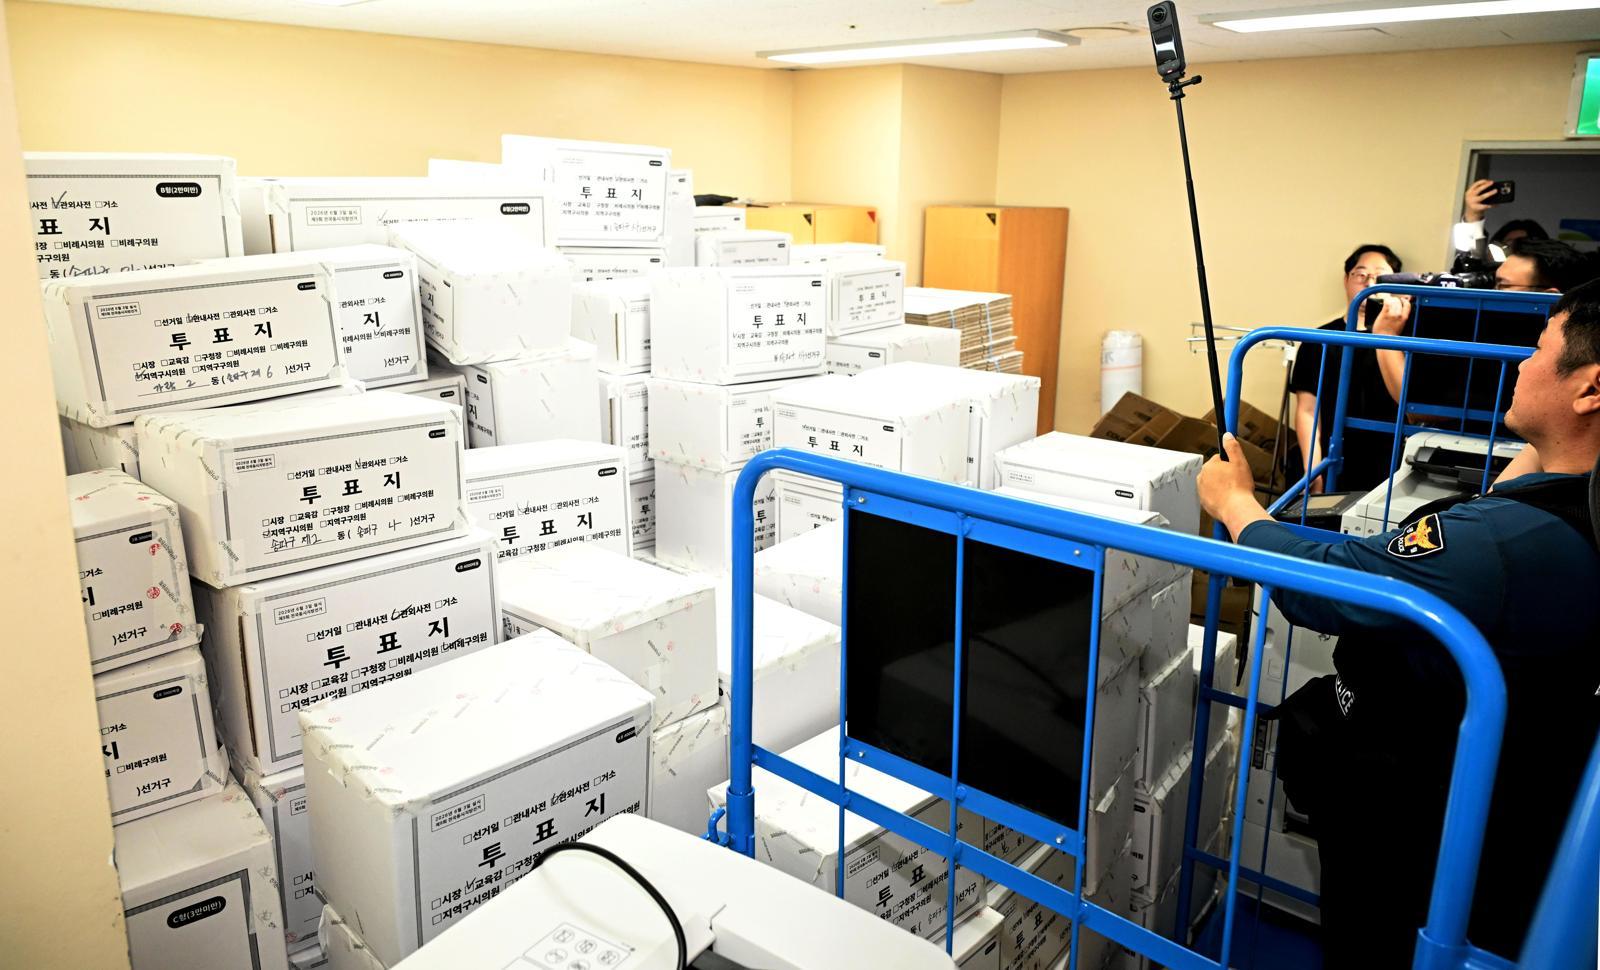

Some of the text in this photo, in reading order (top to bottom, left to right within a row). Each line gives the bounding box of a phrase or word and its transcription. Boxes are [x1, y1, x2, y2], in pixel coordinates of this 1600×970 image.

[30, 201, 48, 209] 사전
[103, 201, 119, 209] 거소
[62, 238, 159, 250] 비례시의원 비례구의원
[162, 316, 183, 327] 선거일
[230, 308, 256, 318] 관외사전
[265, 306, 278, 314] 거소
[380, 327, 411, 338] 비례구의원
[141, 339, 308, 370] 시장 교육감 구청장 비례시의원 비례구의원
[143, 360, 240, 381] 지역구시의원 지역구구의원
[294, 455, 409, 480] 선거일 관내사전 관외사전 거소
[270, 489, 434, 526] 시장 교육감 구청장 비례시의원 비례구의원
[496, 496, 600, 520] 선거일 관내사전 관외사전 거소
[270, 513, 367, 537] 지역구시의원 지역구구의원
[498, 548, 519, 559] 교육감
[526, 543, 546, 554] 구청장
[592, 528, 621, 540] 비례구의원
[86, 568, 103, 577] 거소
[101, 600, 144, 618] 비례구의원
[316, 625, 342, 641] 선거일
[355, 614, 388, 632] 관내사전
[442, 596, 458, 607] 거소
[290, 683, 308, 697] 시장
[321, 672, 349, 688] 교육감
[360, 661, 387, 677] 구청장
[398, 646, 439, 666] 비례시의원
[109, 723, 127, 733] 거소
[125, 753, 168, 771] 비례구의원
[472, 821, 500, 841] 선거일
[512, 801, 547, 824] 관내사전
[601, 769, 617, 783] 거소
[303, 871, 313, 882] 시
[442, 888, 462, 904] 시장
[474, 869, 503, 891] 교육감
[872, 868, 889, 885] 선거일
[172, 900, 223, 925] C형(3만미만)
[442, 885, 500, 920] 지역구시의원
[880, 909, 892, 920] 육감
[899, 892, 916, 909] 구청장
